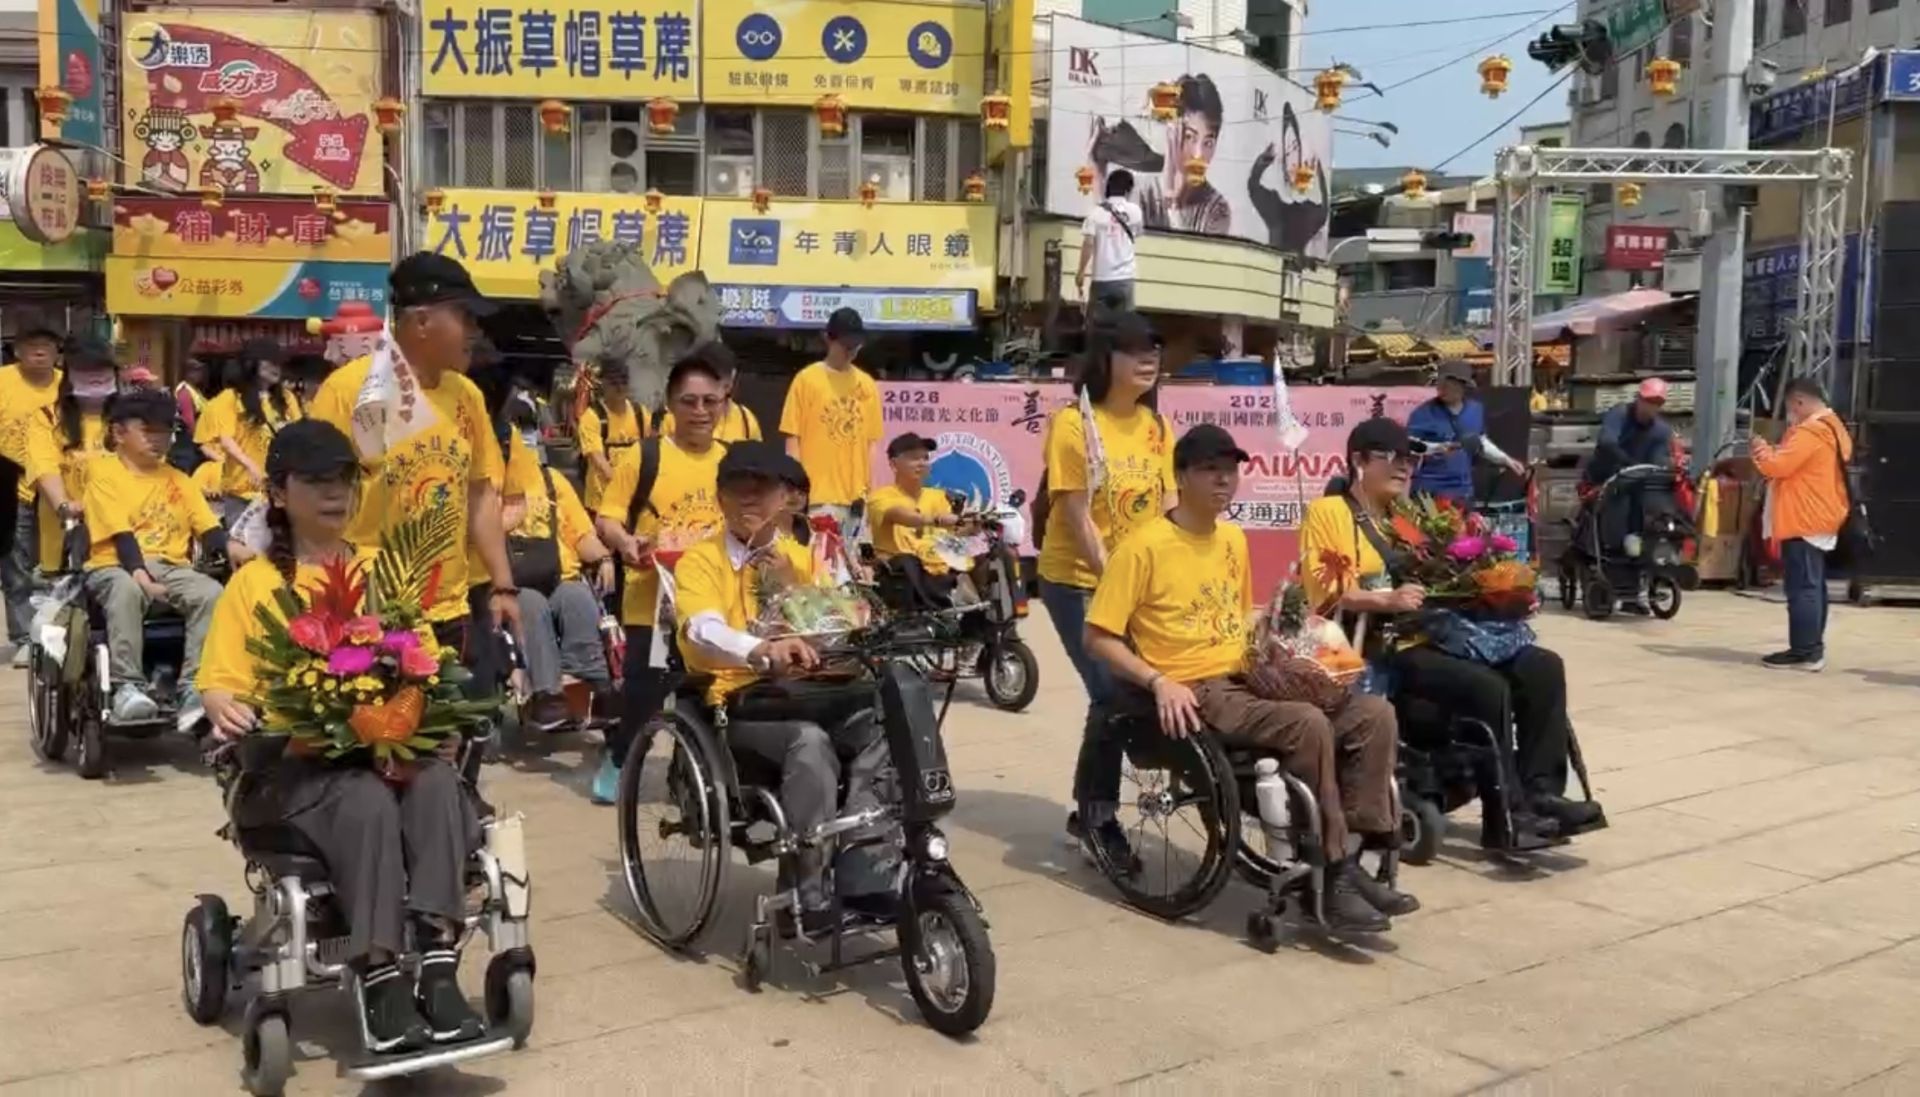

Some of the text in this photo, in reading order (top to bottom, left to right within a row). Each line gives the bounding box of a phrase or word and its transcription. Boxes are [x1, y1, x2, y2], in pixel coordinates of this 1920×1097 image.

[430, 8, 691, 82] 大振草帽草席
[1070, 46, 1098, 75] DK
[176, 211, 327, 245] 補財庫
[795, 230, 970, 257] 年青人眼鏡
[180, 278, 243, 295] 公益彩券
[885, 391, 939, 403] 2026
[883, 407, 999, 422] 國際觀光文化節
[1244, 455, 1347, 477] AIWA
